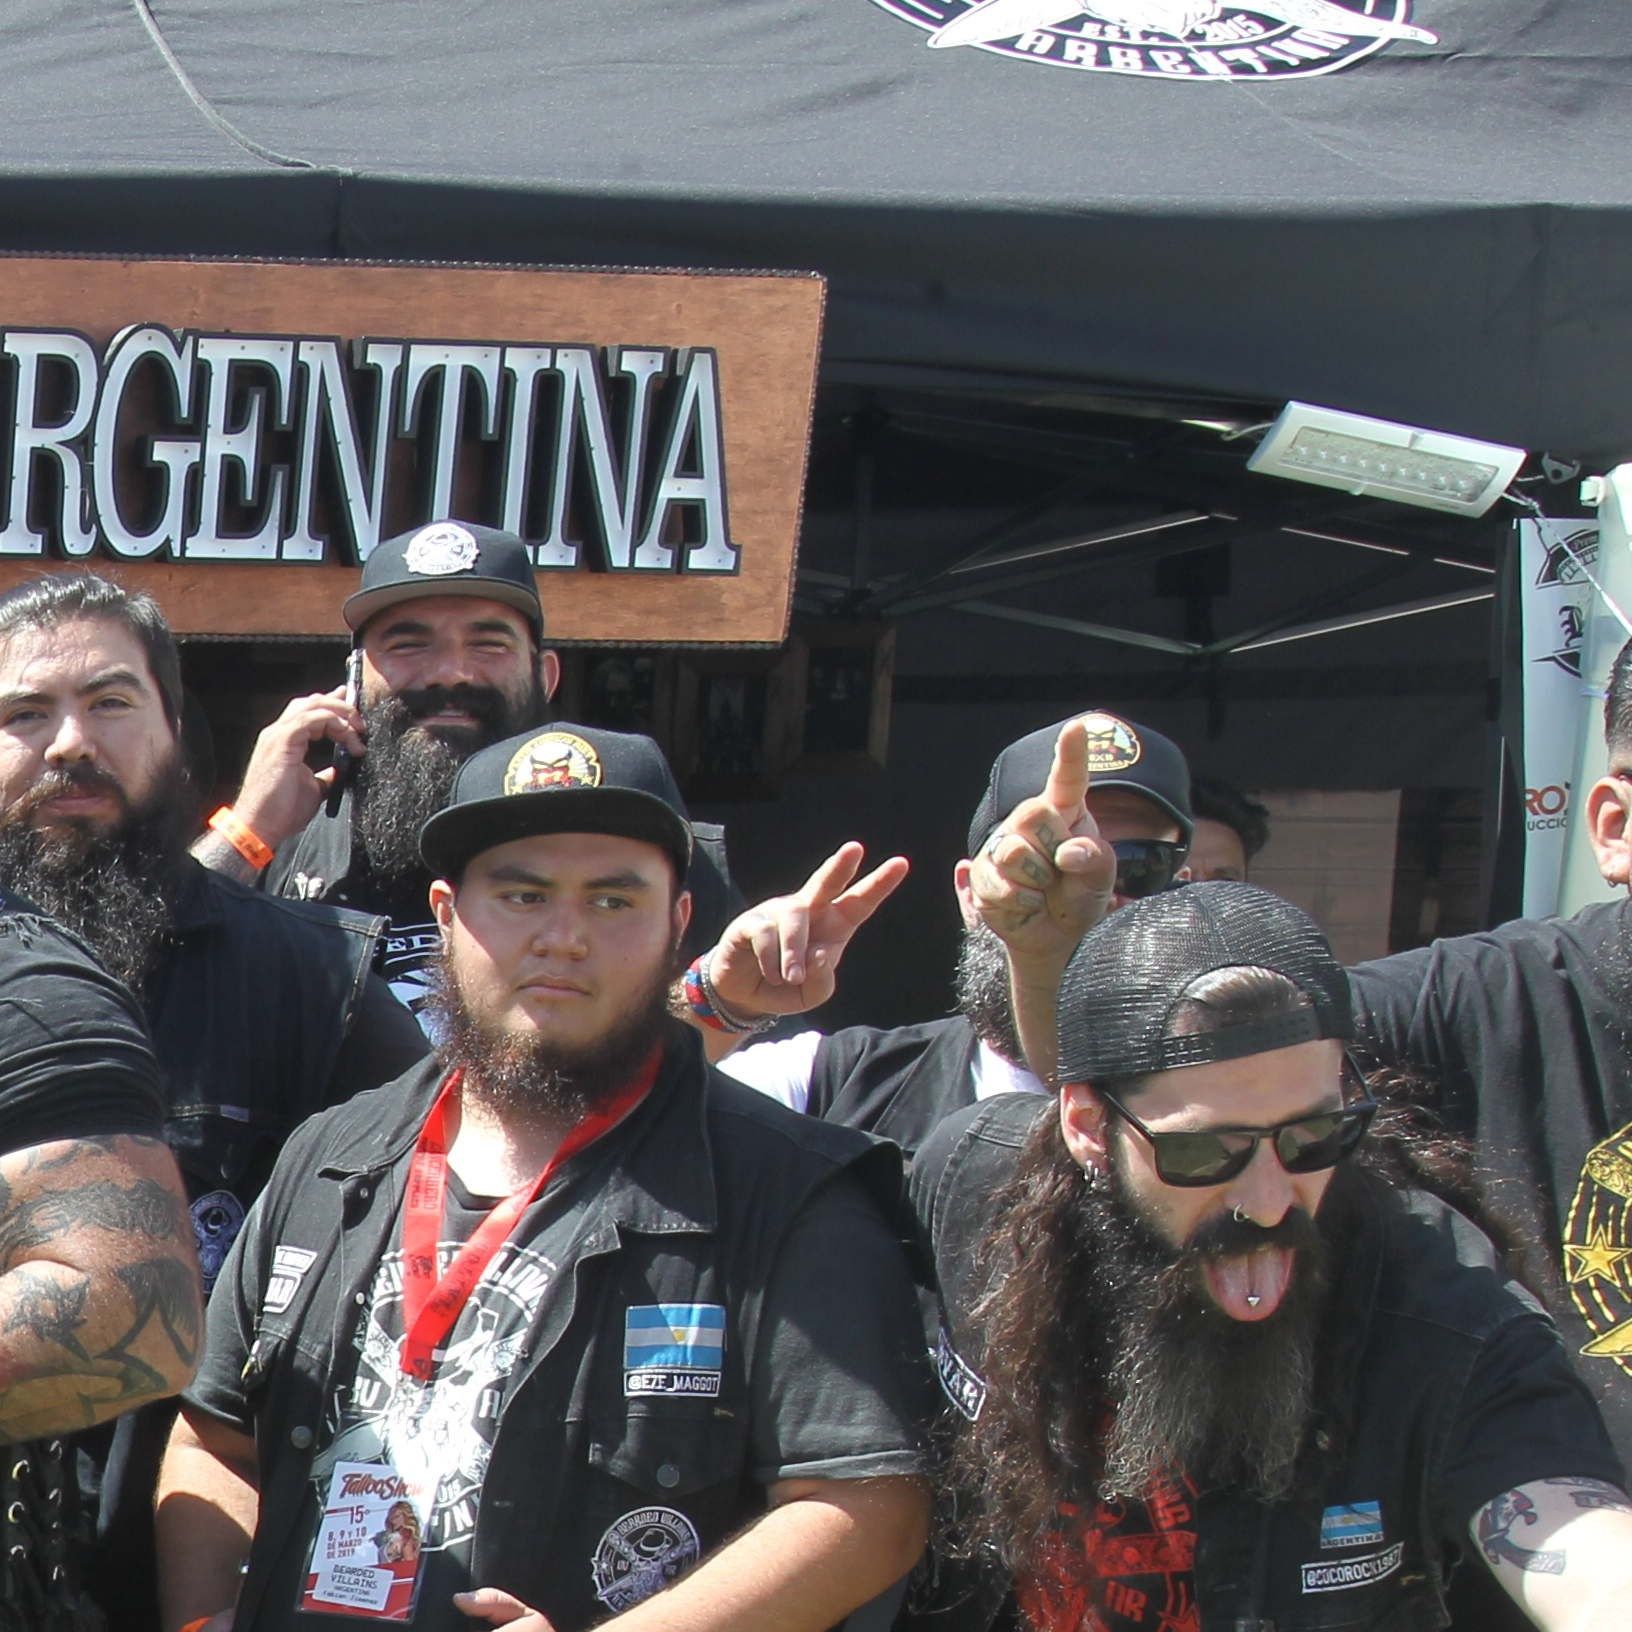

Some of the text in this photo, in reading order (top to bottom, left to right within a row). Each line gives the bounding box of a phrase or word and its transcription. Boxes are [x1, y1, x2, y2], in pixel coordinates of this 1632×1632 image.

[338, 1538, 363, 1549] MARZO
[333, 1563, 376, 1579] BEARDED
[331, 1574, 378, 1589] VILLAINS
